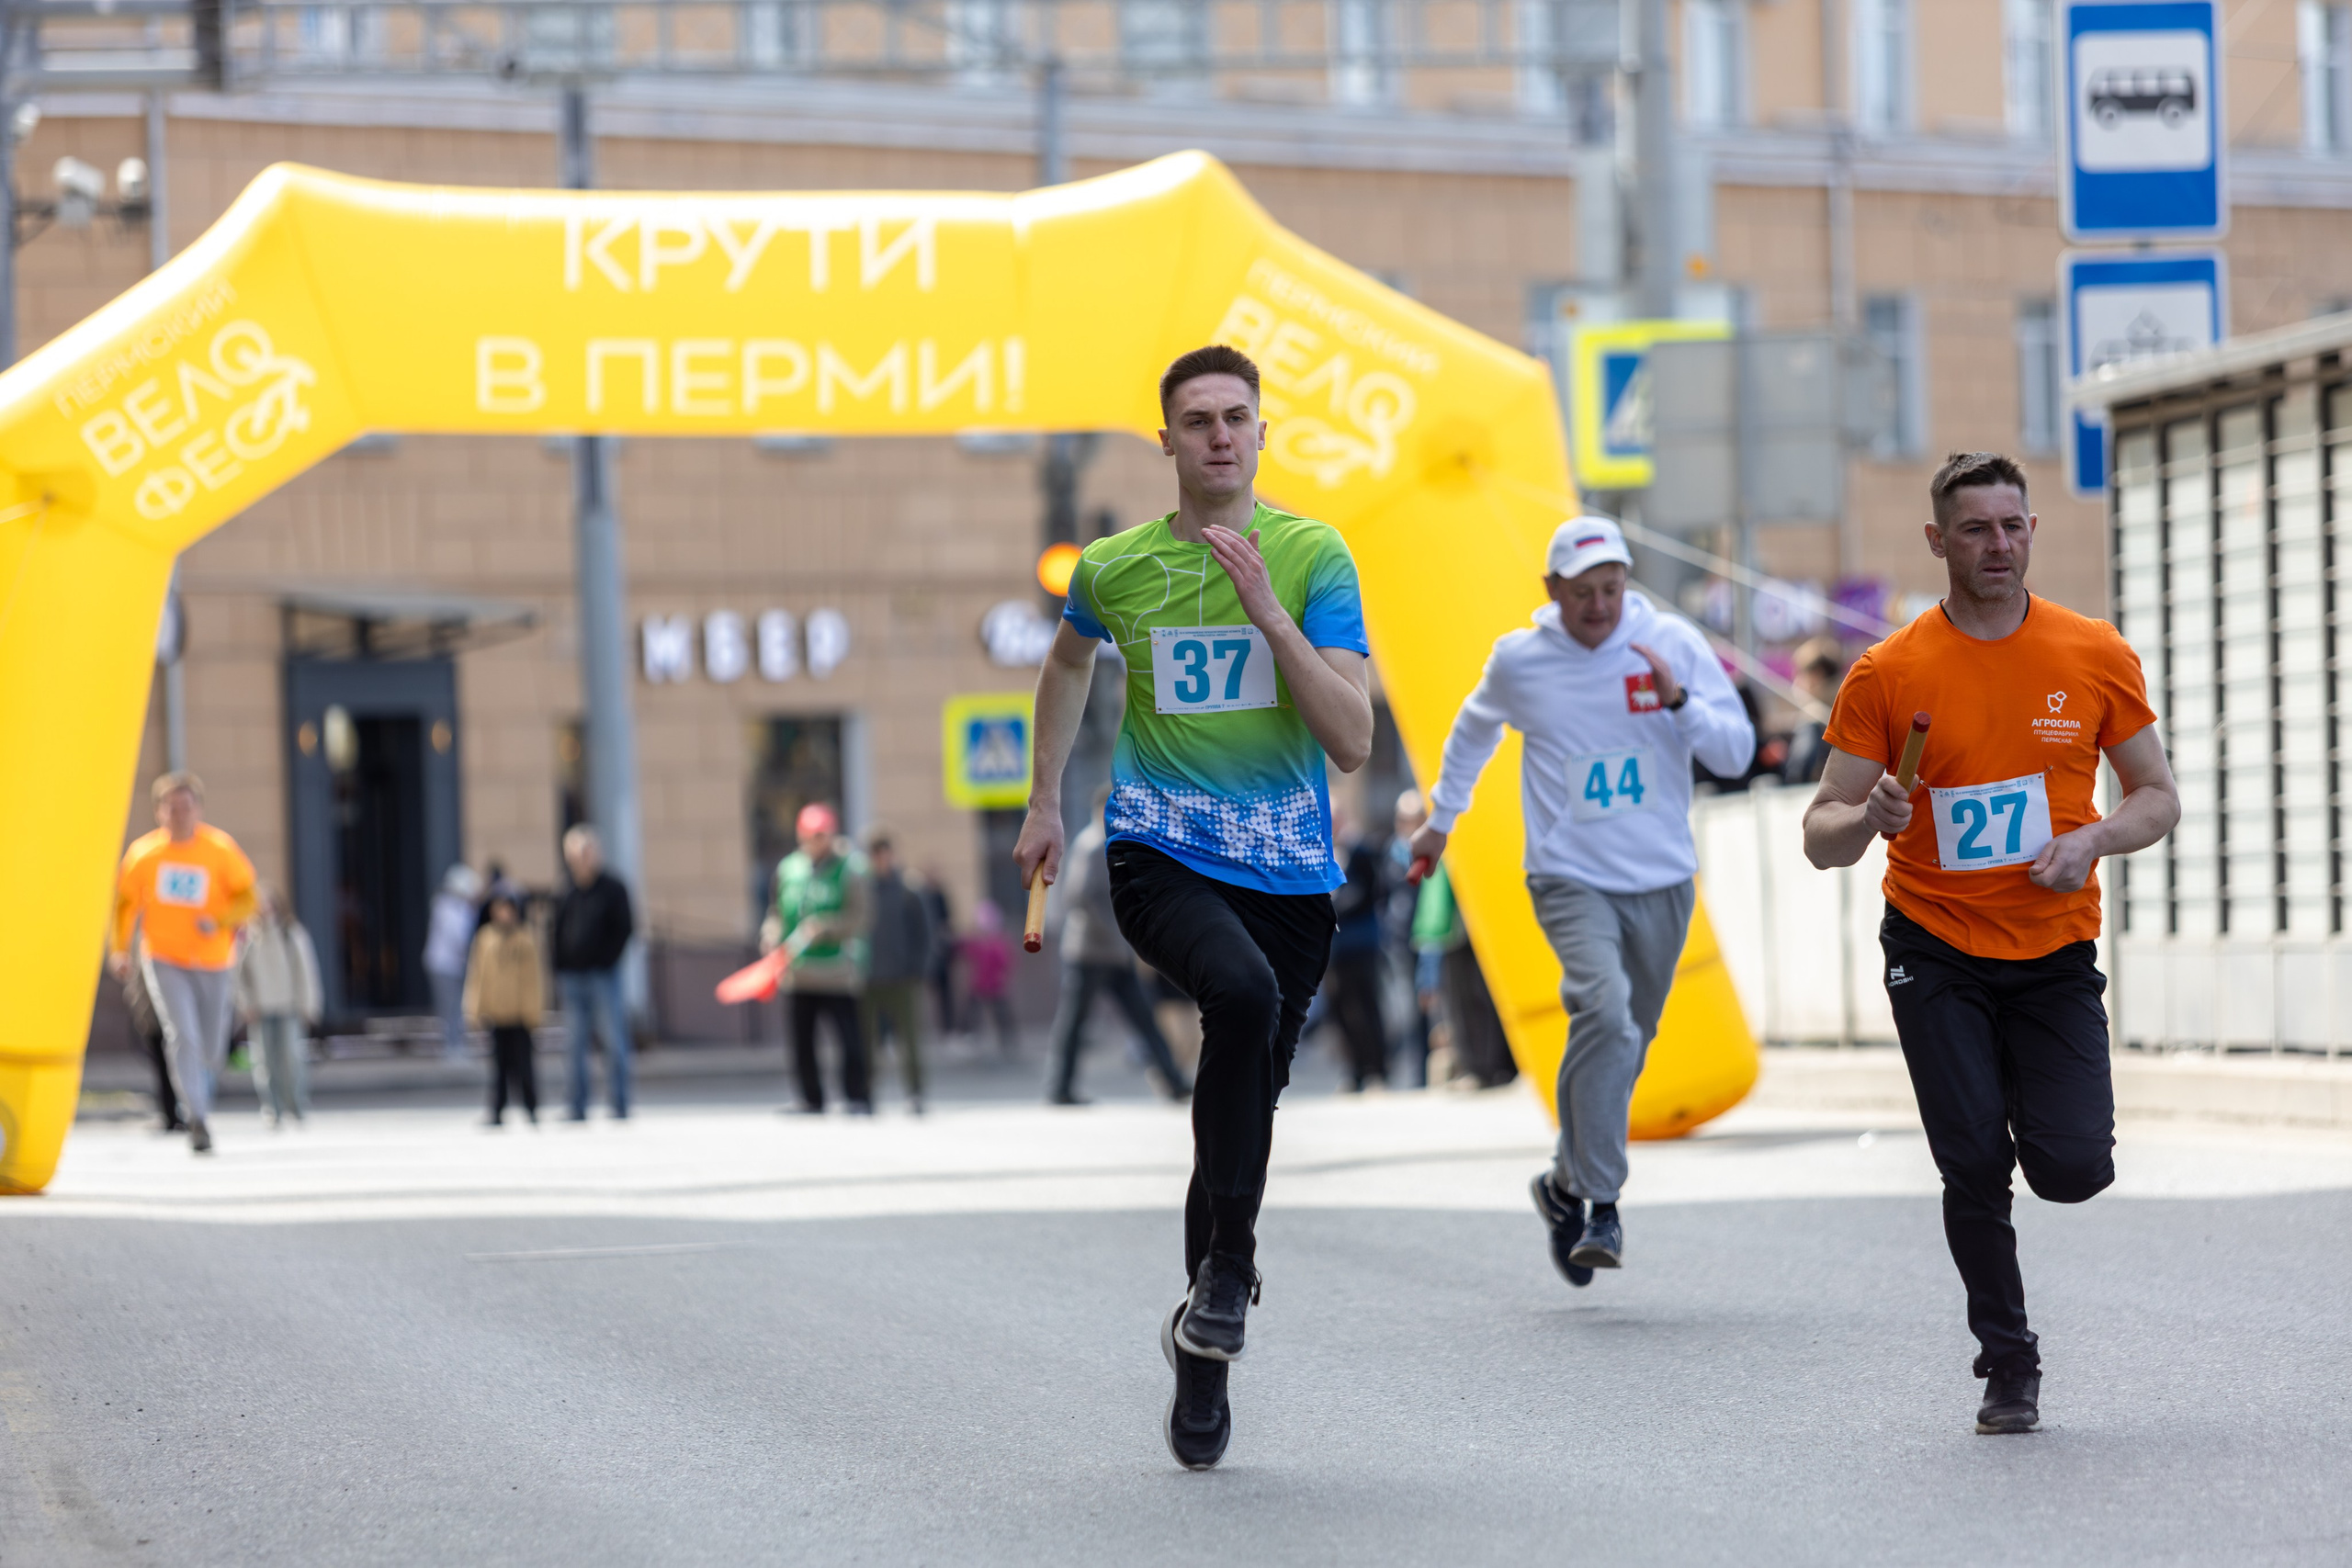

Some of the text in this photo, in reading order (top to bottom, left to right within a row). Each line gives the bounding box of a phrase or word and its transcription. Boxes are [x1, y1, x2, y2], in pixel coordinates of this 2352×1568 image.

[563, 217, 936, 292] КРУТИ
[475, 336, 1026, 415] В ПЕРМИ!
[1173, 638, 1250, 703] 37
[2031, 718, 2081, 728] АГРОСИЛА
[1585, 757, 1645, 807] 44
[1951, 790, 2028, 860] 27
